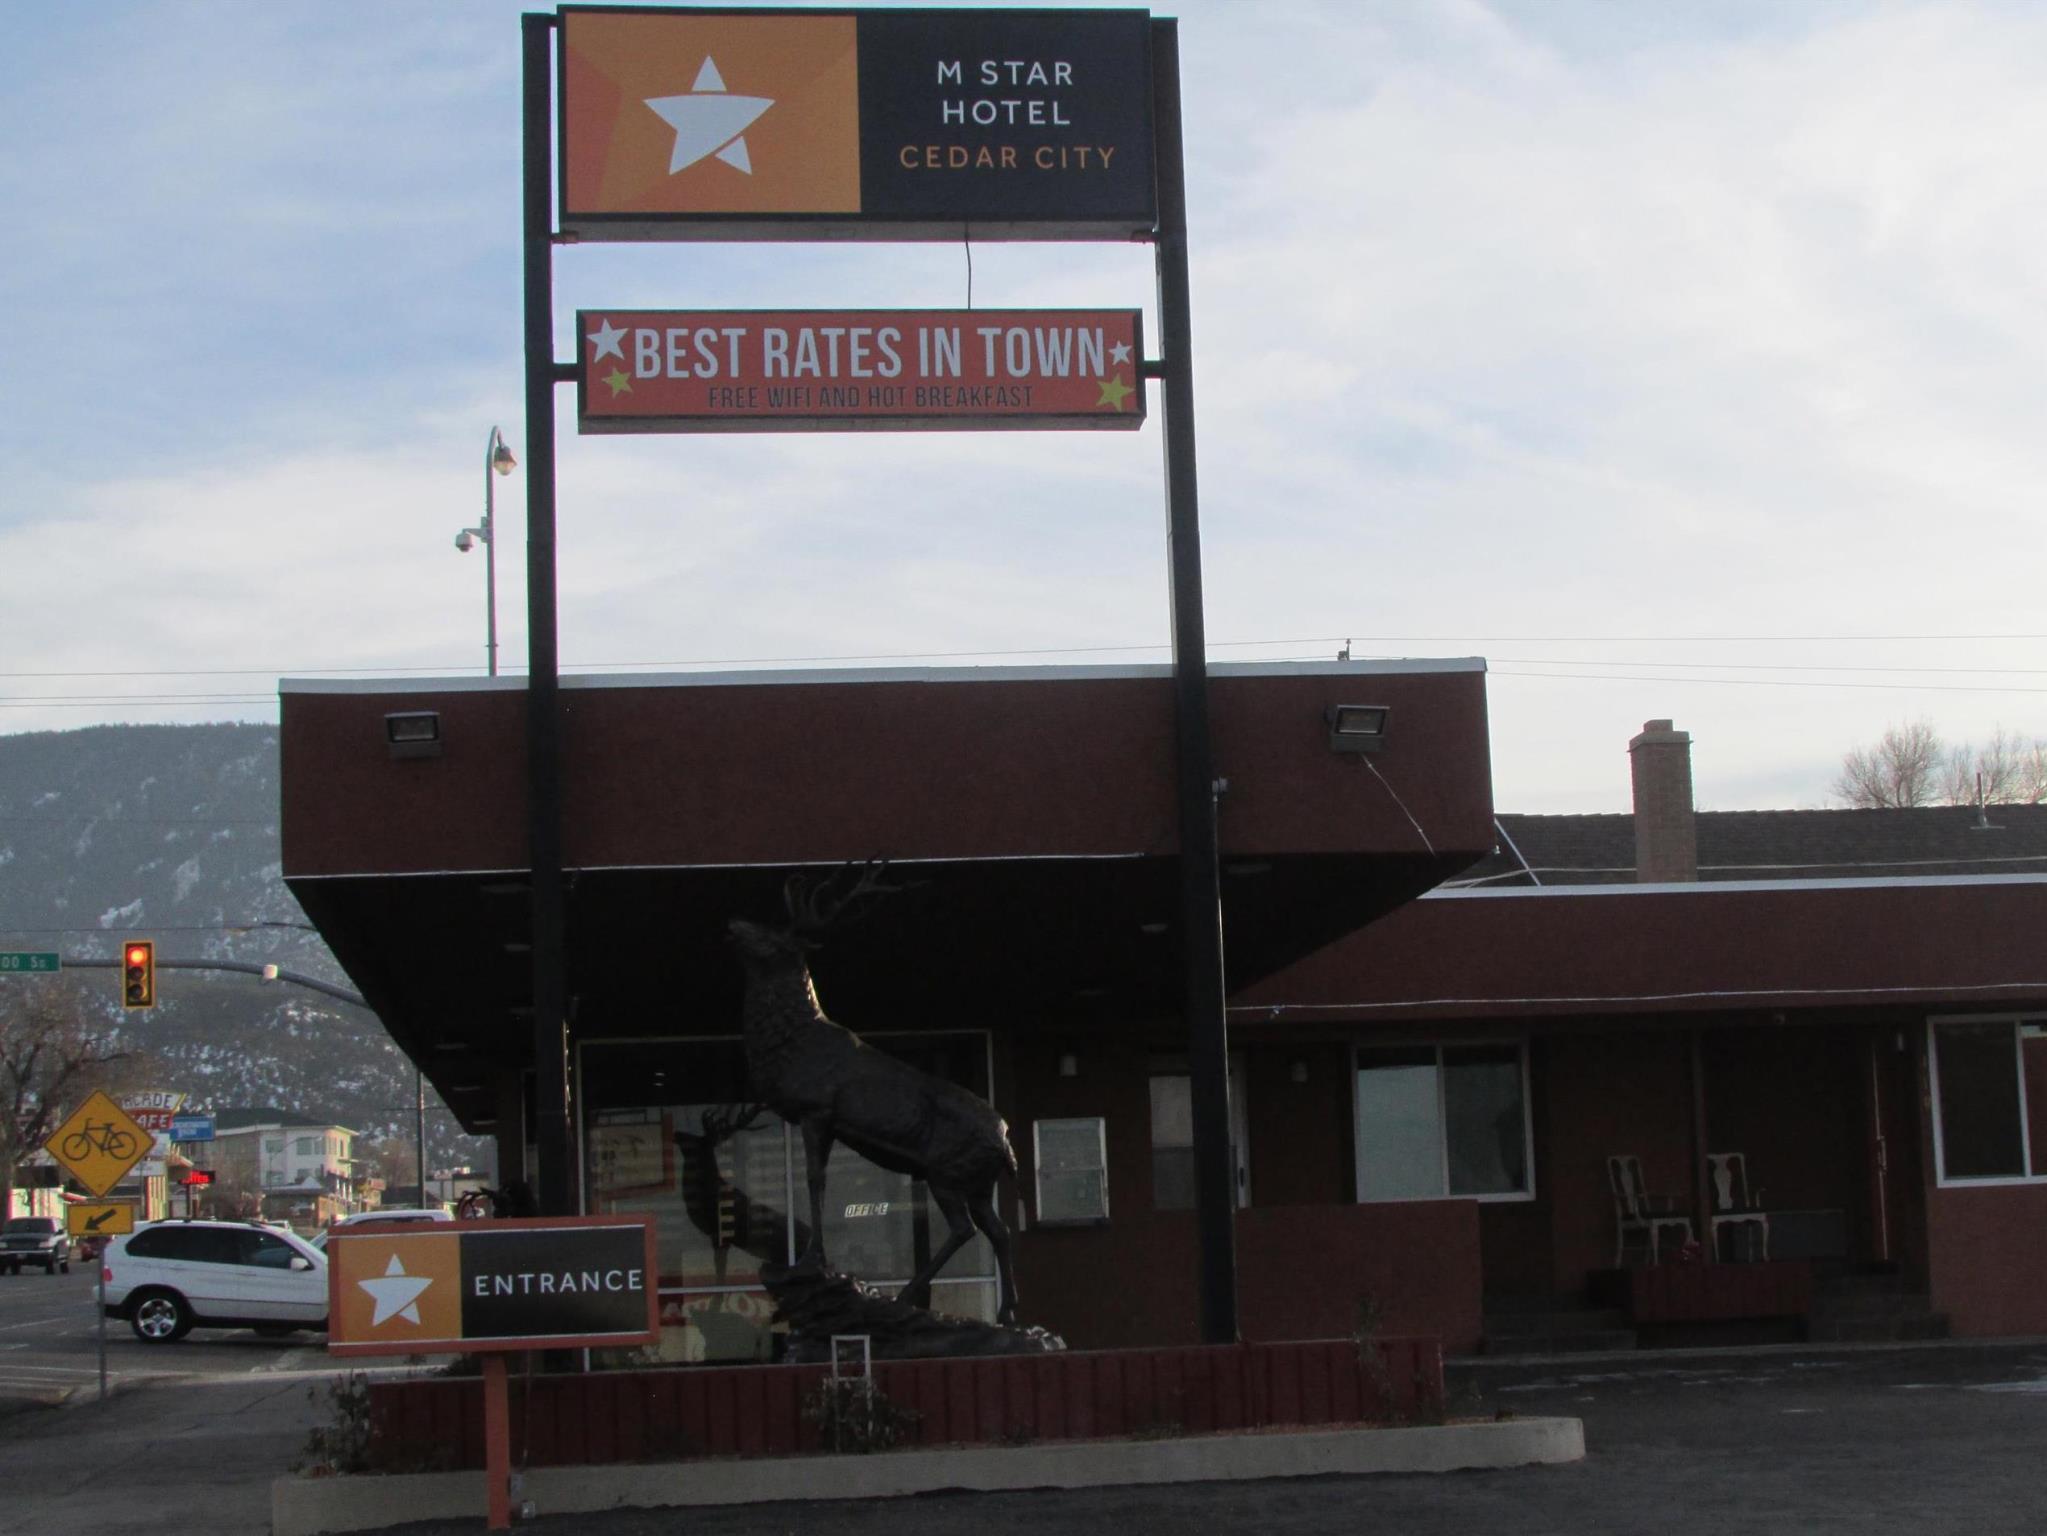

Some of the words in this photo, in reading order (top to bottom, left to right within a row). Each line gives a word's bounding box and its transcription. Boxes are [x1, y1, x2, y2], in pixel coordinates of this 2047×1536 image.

[938, 61, 962, 84] M
[981, 61, 1073, 85] STAR
[943, 100, 1071, 125] HOTEL
[900, 145, 1017, 168] CEDAR
[1035, 146, 1114, 169] CITY
[635, 327, 747, 378] BEST
[764, 327, 902, 378] RATES
[919, 327, 961, 377] IN
[977, 327, 1105, 377] TOWN
[709, 387, 758, 408] FREE
[767, 387, 811, 408] WIFI
[819, 387, 860, 407] AND
[868, 386, 907, 407] HOT
[915, 386, 1034, 407] BREAKFAST
[131, 1114, 169, 1129] AFE
[845, 1202, 888, 1217] OFFICE
[473, 1269, 643, 1297] ENTRANCE
